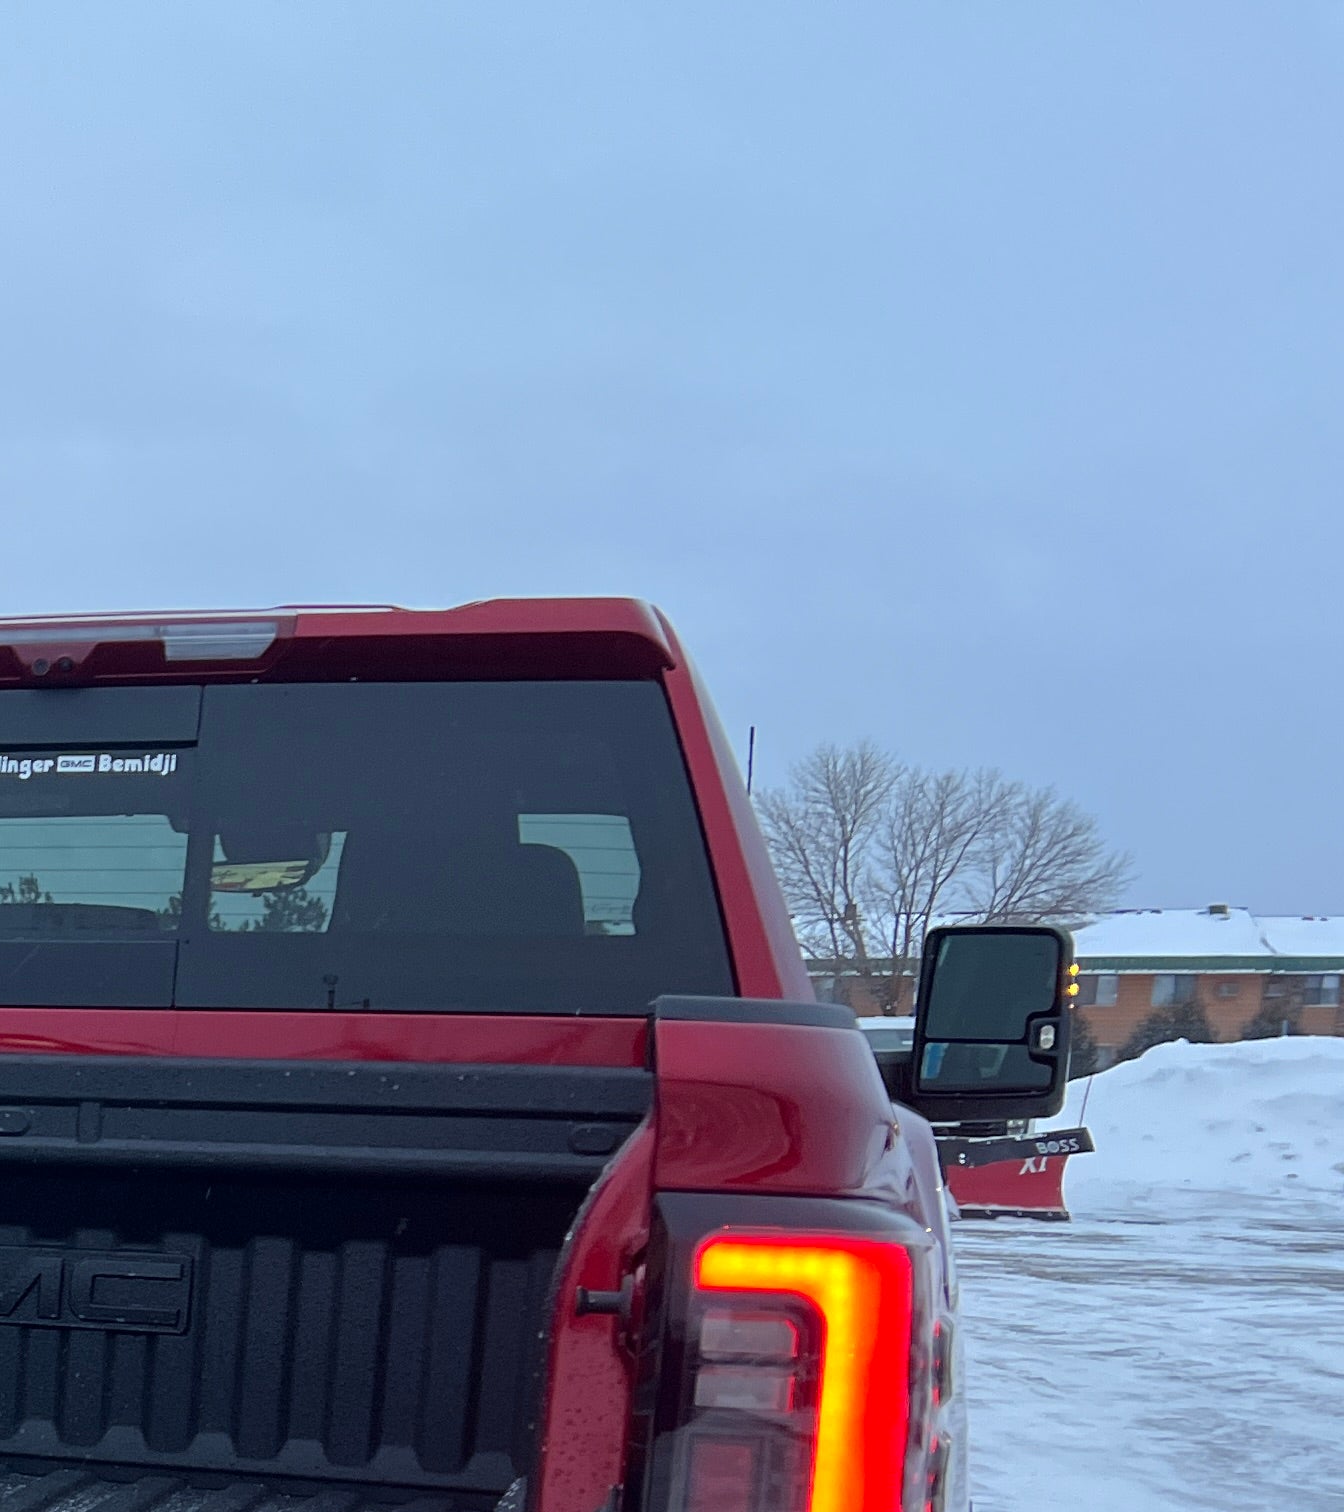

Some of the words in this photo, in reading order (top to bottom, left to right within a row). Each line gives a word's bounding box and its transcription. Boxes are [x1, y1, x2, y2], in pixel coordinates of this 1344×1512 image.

[59, 757, 94, 770] GMC
[98, 754, 177, 775] Bemidji
[1035, 1138, 1080, 1155] BOSS
